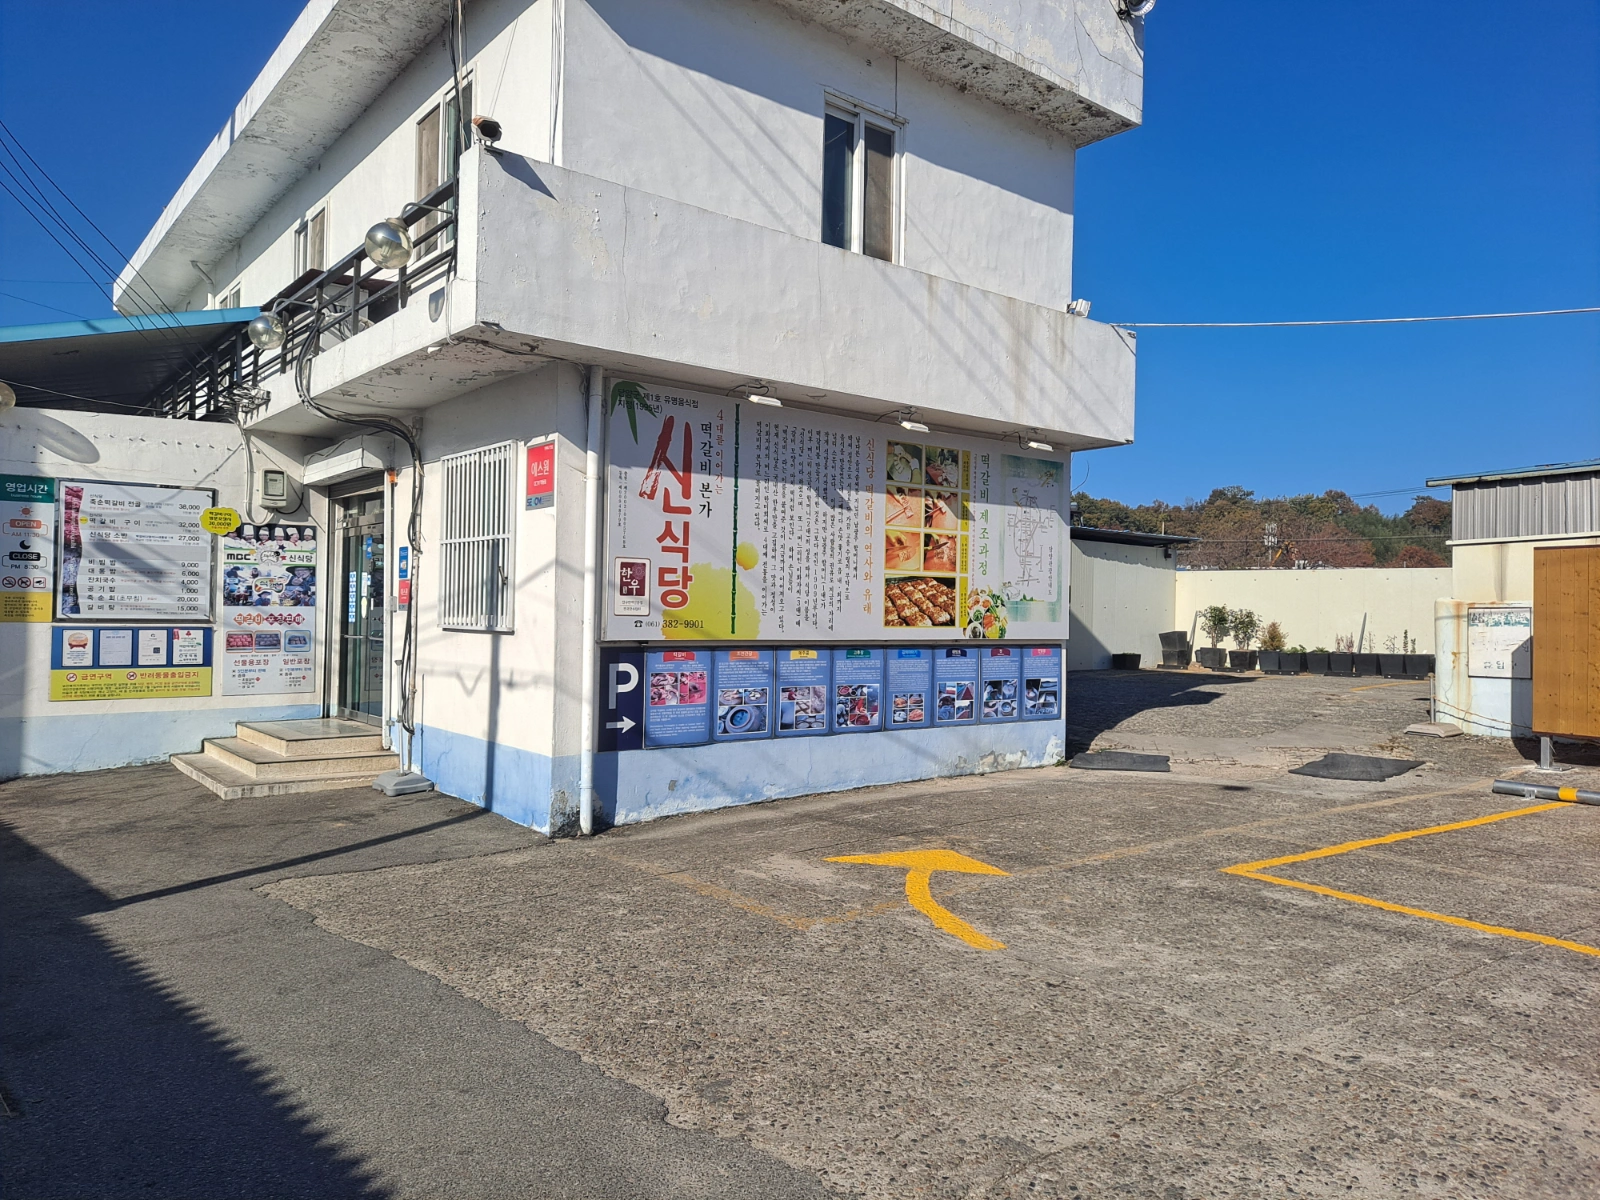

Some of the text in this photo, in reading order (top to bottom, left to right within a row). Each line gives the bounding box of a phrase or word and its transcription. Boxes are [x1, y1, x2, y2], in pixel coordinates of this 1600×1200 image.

[643, 391, 662, 404] 제1호
[664, 396, 699, 409] 유명음식점
[715, 409, 725, 495] 4대를 이어가는
[699, 422, 714, 518] 떡갈비 본가
[5, 482, 49, 494] 영업시간
[638, 414, 694, 609] 신식당
[978, 453, 991, 576] 떡갈비 제조과정
[178, 522, 200, 530] 32,000
[862, 438, 875, 615] 신식당 떡갈비의 역사와 유래
[89, 531, 112, 539] 신식당
[12, 552, 38, 560] CLOSE
[226, 553, 251, 561] MBC
[289, 555, 314, 564] 신식당
[181, 579, 199, 587] 4,000
[620, 567, 640, 596] 한우
[177, 605, 199, 613] 15,000
[662, 619, 704, 629] 382-9901
[282, 657, 310, 666] 일반포장
[80, 673, 112, 682] 금연구역
[608, 662, 639, 710] P
